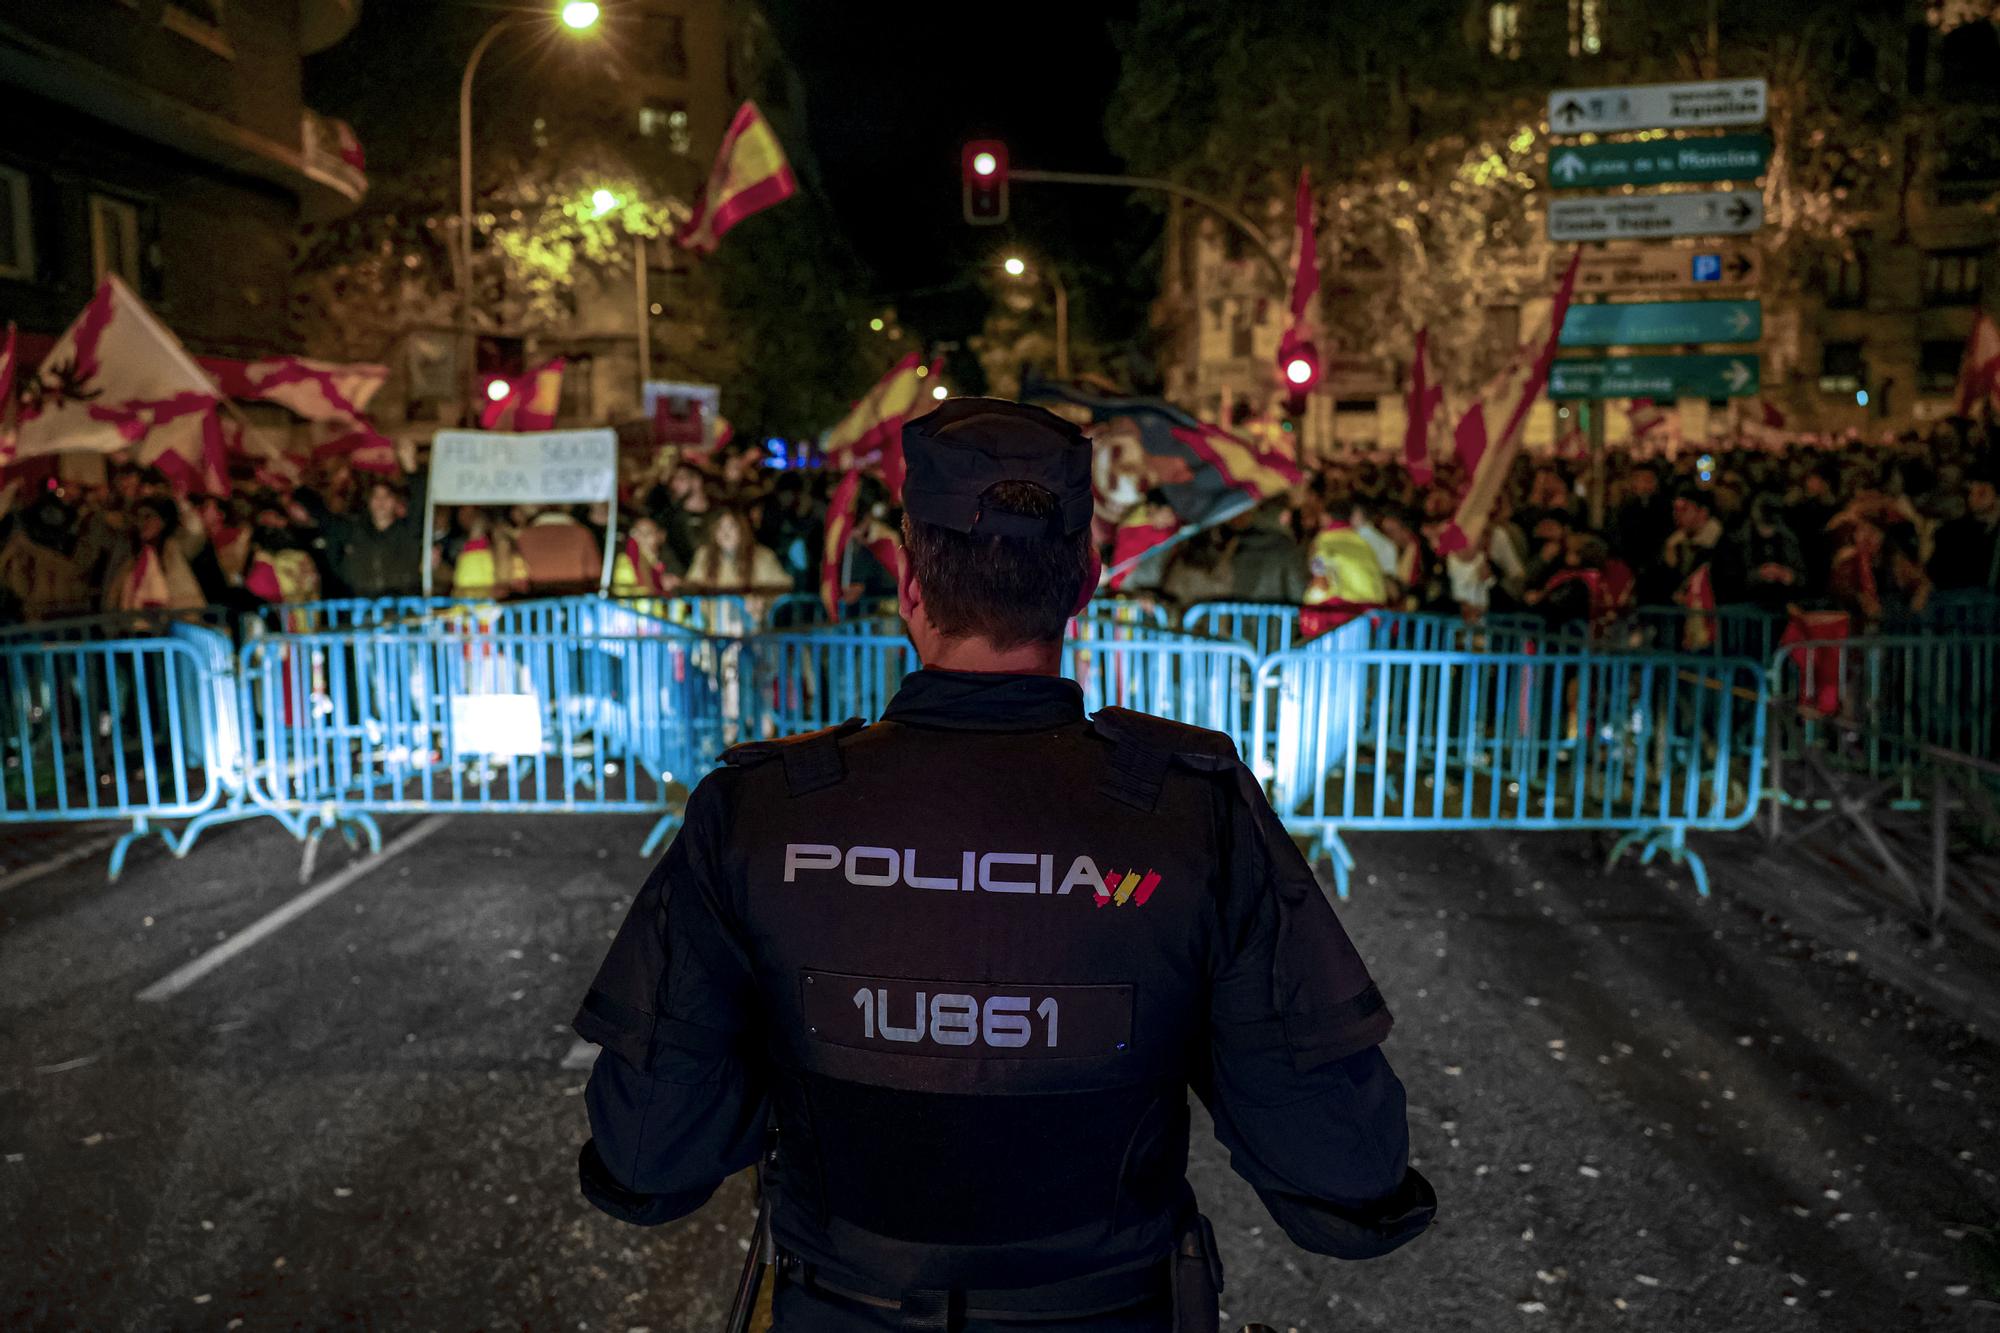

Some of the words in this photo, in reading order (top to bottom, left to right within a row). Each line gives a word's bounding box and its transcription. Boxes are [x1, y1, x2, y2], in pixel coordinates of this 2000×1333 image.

[456, 468, 531, 493] PARA
[784, 844, 1110, 896] POLICIA
[853, 987, 1059, 1049] 1U861
